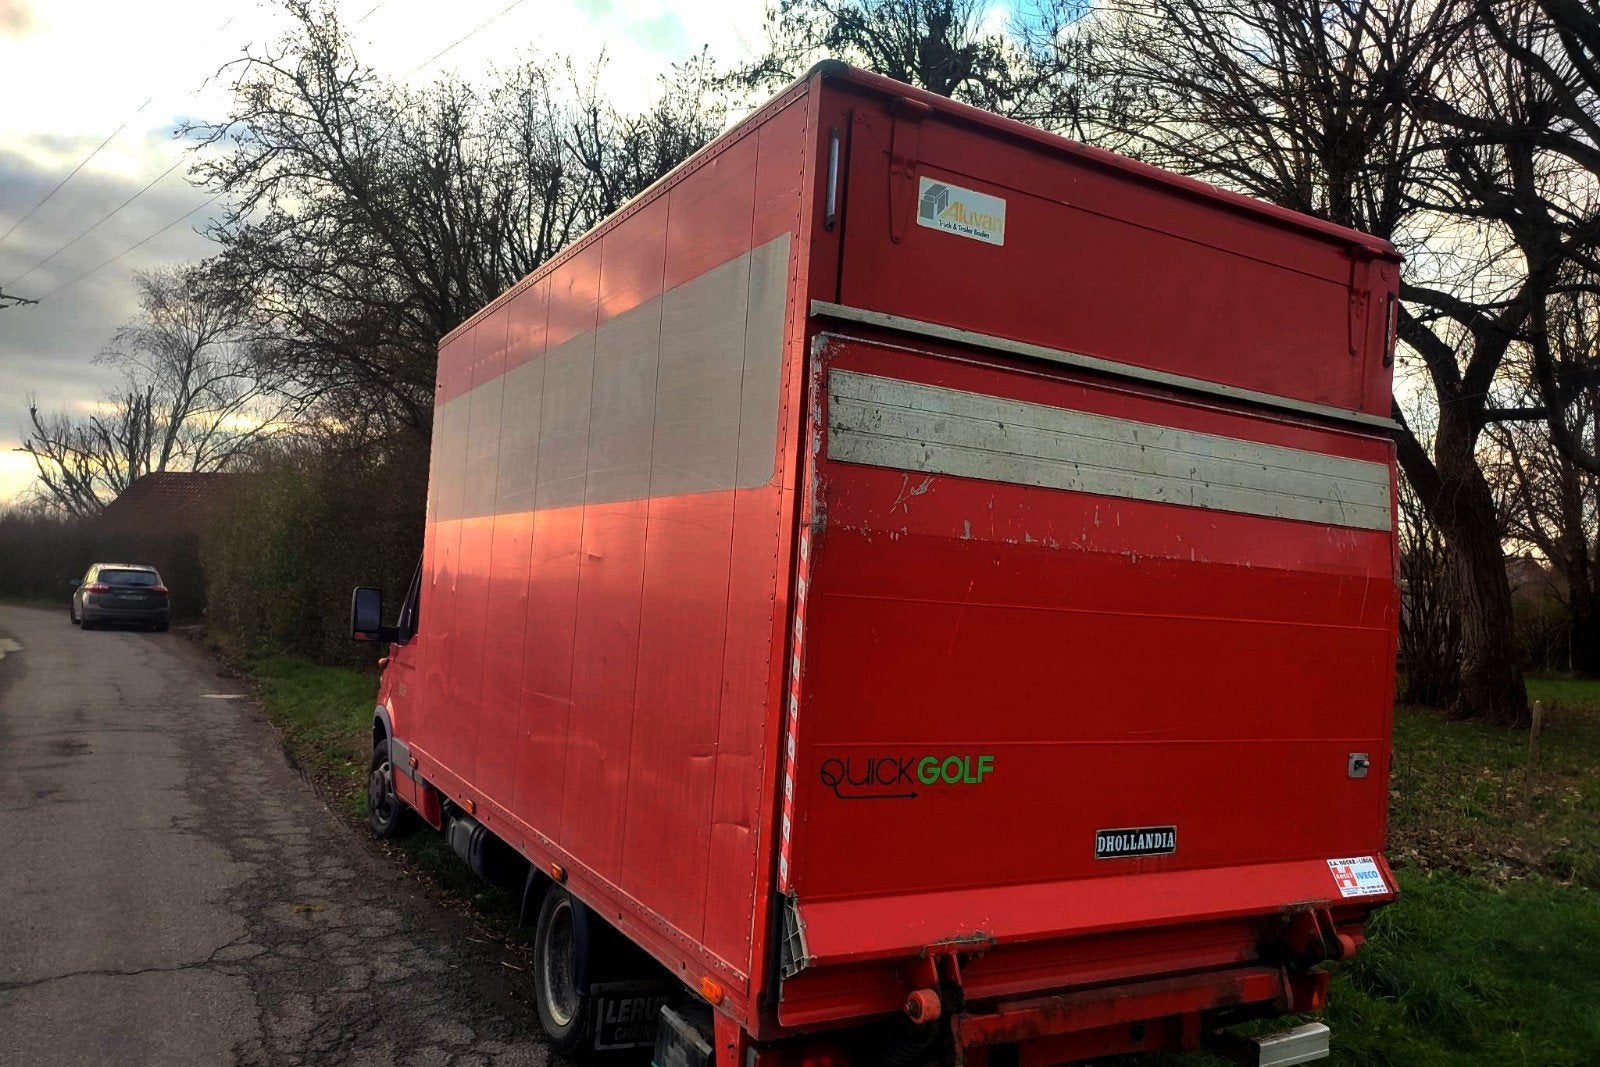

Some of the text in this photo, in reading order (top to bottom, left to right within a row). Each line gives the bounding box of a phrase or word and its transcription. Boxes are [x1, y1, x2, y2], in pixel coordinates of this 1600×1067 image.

[939, 219, 952, 229] Truck
[958, 224, 973, 234] Trailer
[974, 229, 990, 239] Bodies
[1097, 832, 1174, 852] DHOLLANDIA
[1356, 870, 1378, 879] IVECO
